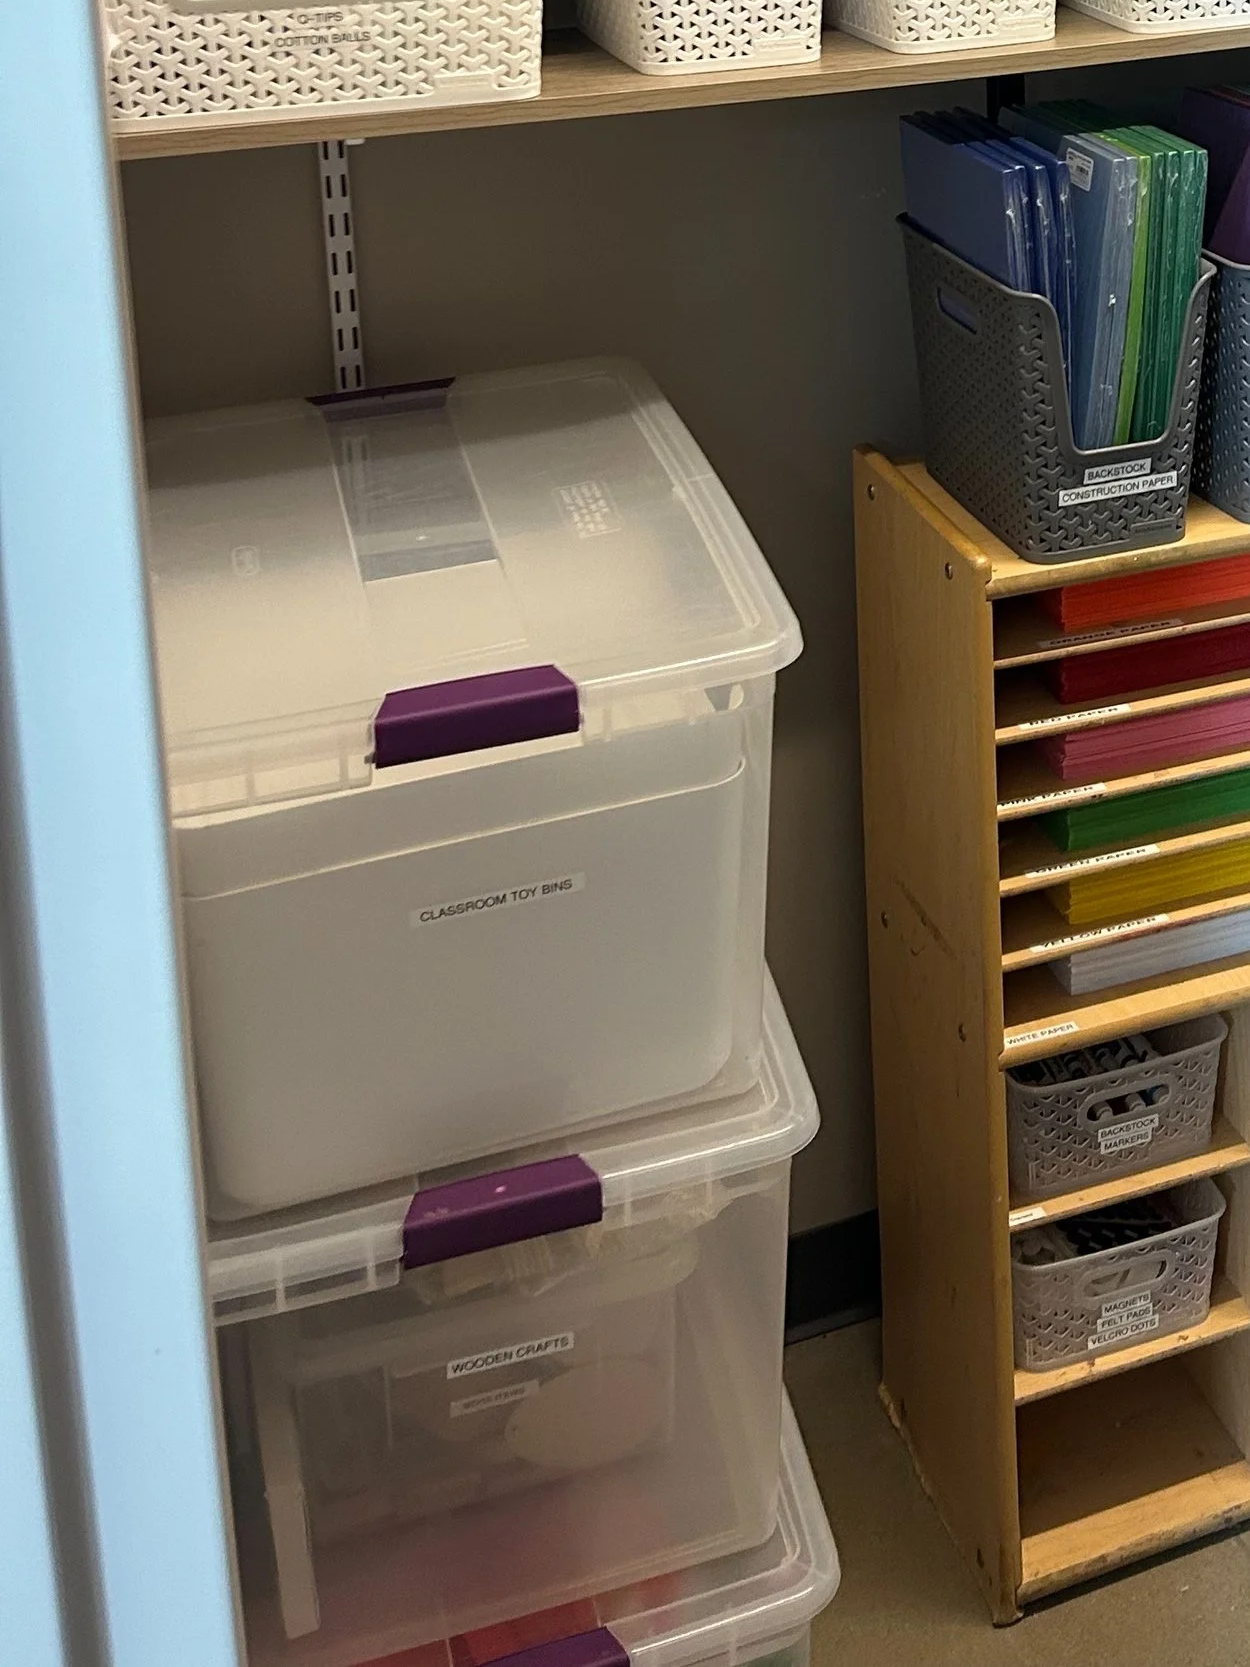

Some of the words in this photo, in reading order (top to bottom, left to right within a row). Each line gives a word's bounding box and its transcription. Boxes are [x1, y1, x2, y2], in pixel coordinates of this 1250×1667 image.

[297, 12, 344, 23] Q-TIPS
[275, 33, 330, 46] COTTON
[332, 31, 370, 44] BALLS
[1088, 463, 1147, 481] BACKSTOCK
[1062, 481, 1139, 504] CONSTRUCTION
[1141, 475, 1174, 489] PAPER
[420, 892, 507, 922] CLASSROOM
[510, 886, 537, 900] TOY
[541, 878, 572, 894] BINS
[1106, 916, 1157, 933] PAPER
[1007, 1033, 1039, 1045] WHITE
[1040, 1023, 1075, 1036] PAPER
[1100, 1118, 1156, 1139] BACKSTOCK
[1104, 1132, 1150, 1151] MARKERS
[1104, 1294, 1149, 1313] MAGNETS
[1101, 1316, 1124, 1329] FELT
[1126, 1308, 1151, 1321] PADS
[1090, 1327, 1128, 1345] VELCRO
[1130, 1320, 1156, 1333] DOTS
[452, 1349, 514, 1376] WOODEN
[517, 1337, 569, 1361] CRAFTS
